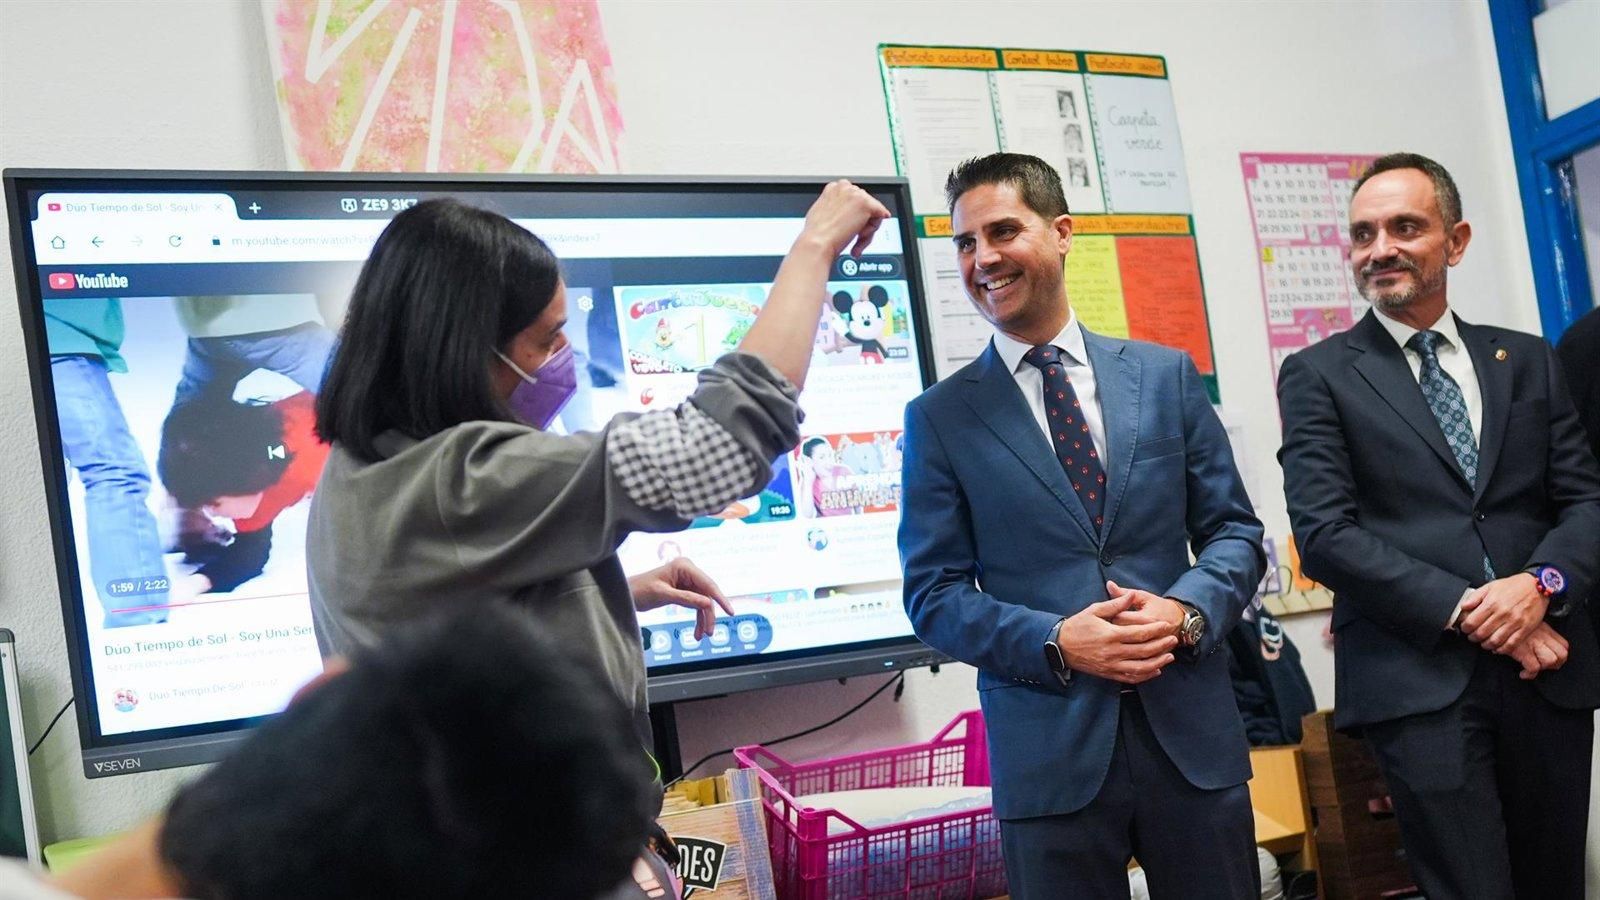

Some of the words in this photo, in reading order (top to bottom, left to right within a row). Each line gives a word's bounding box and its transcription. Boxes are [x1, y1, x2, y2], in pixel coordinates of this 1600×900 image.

[1108, 105, 1160, 134] Carpeta
[90, 203, 128, 215] Tiempo
[131, 203, 143, 212] de
[146, 203, 162, 212] Sol
[170, 203, 188, 215] Soy
[361, 198, 389, 211] ZE9
[76, 272, 129, 289] YouTube
[111, 582, 134, 593] 1:59
[145, 579, 168, 590] 2:22
[135, 637, 184, 654] Tiempo
[187, 635, 204, 647] de
[206, 633, 228, 645] Sol
[238, 629, 262, 643] Soy
[265, 627, 290, 639] Una
[172, 687, 209, 699] Tiempo
